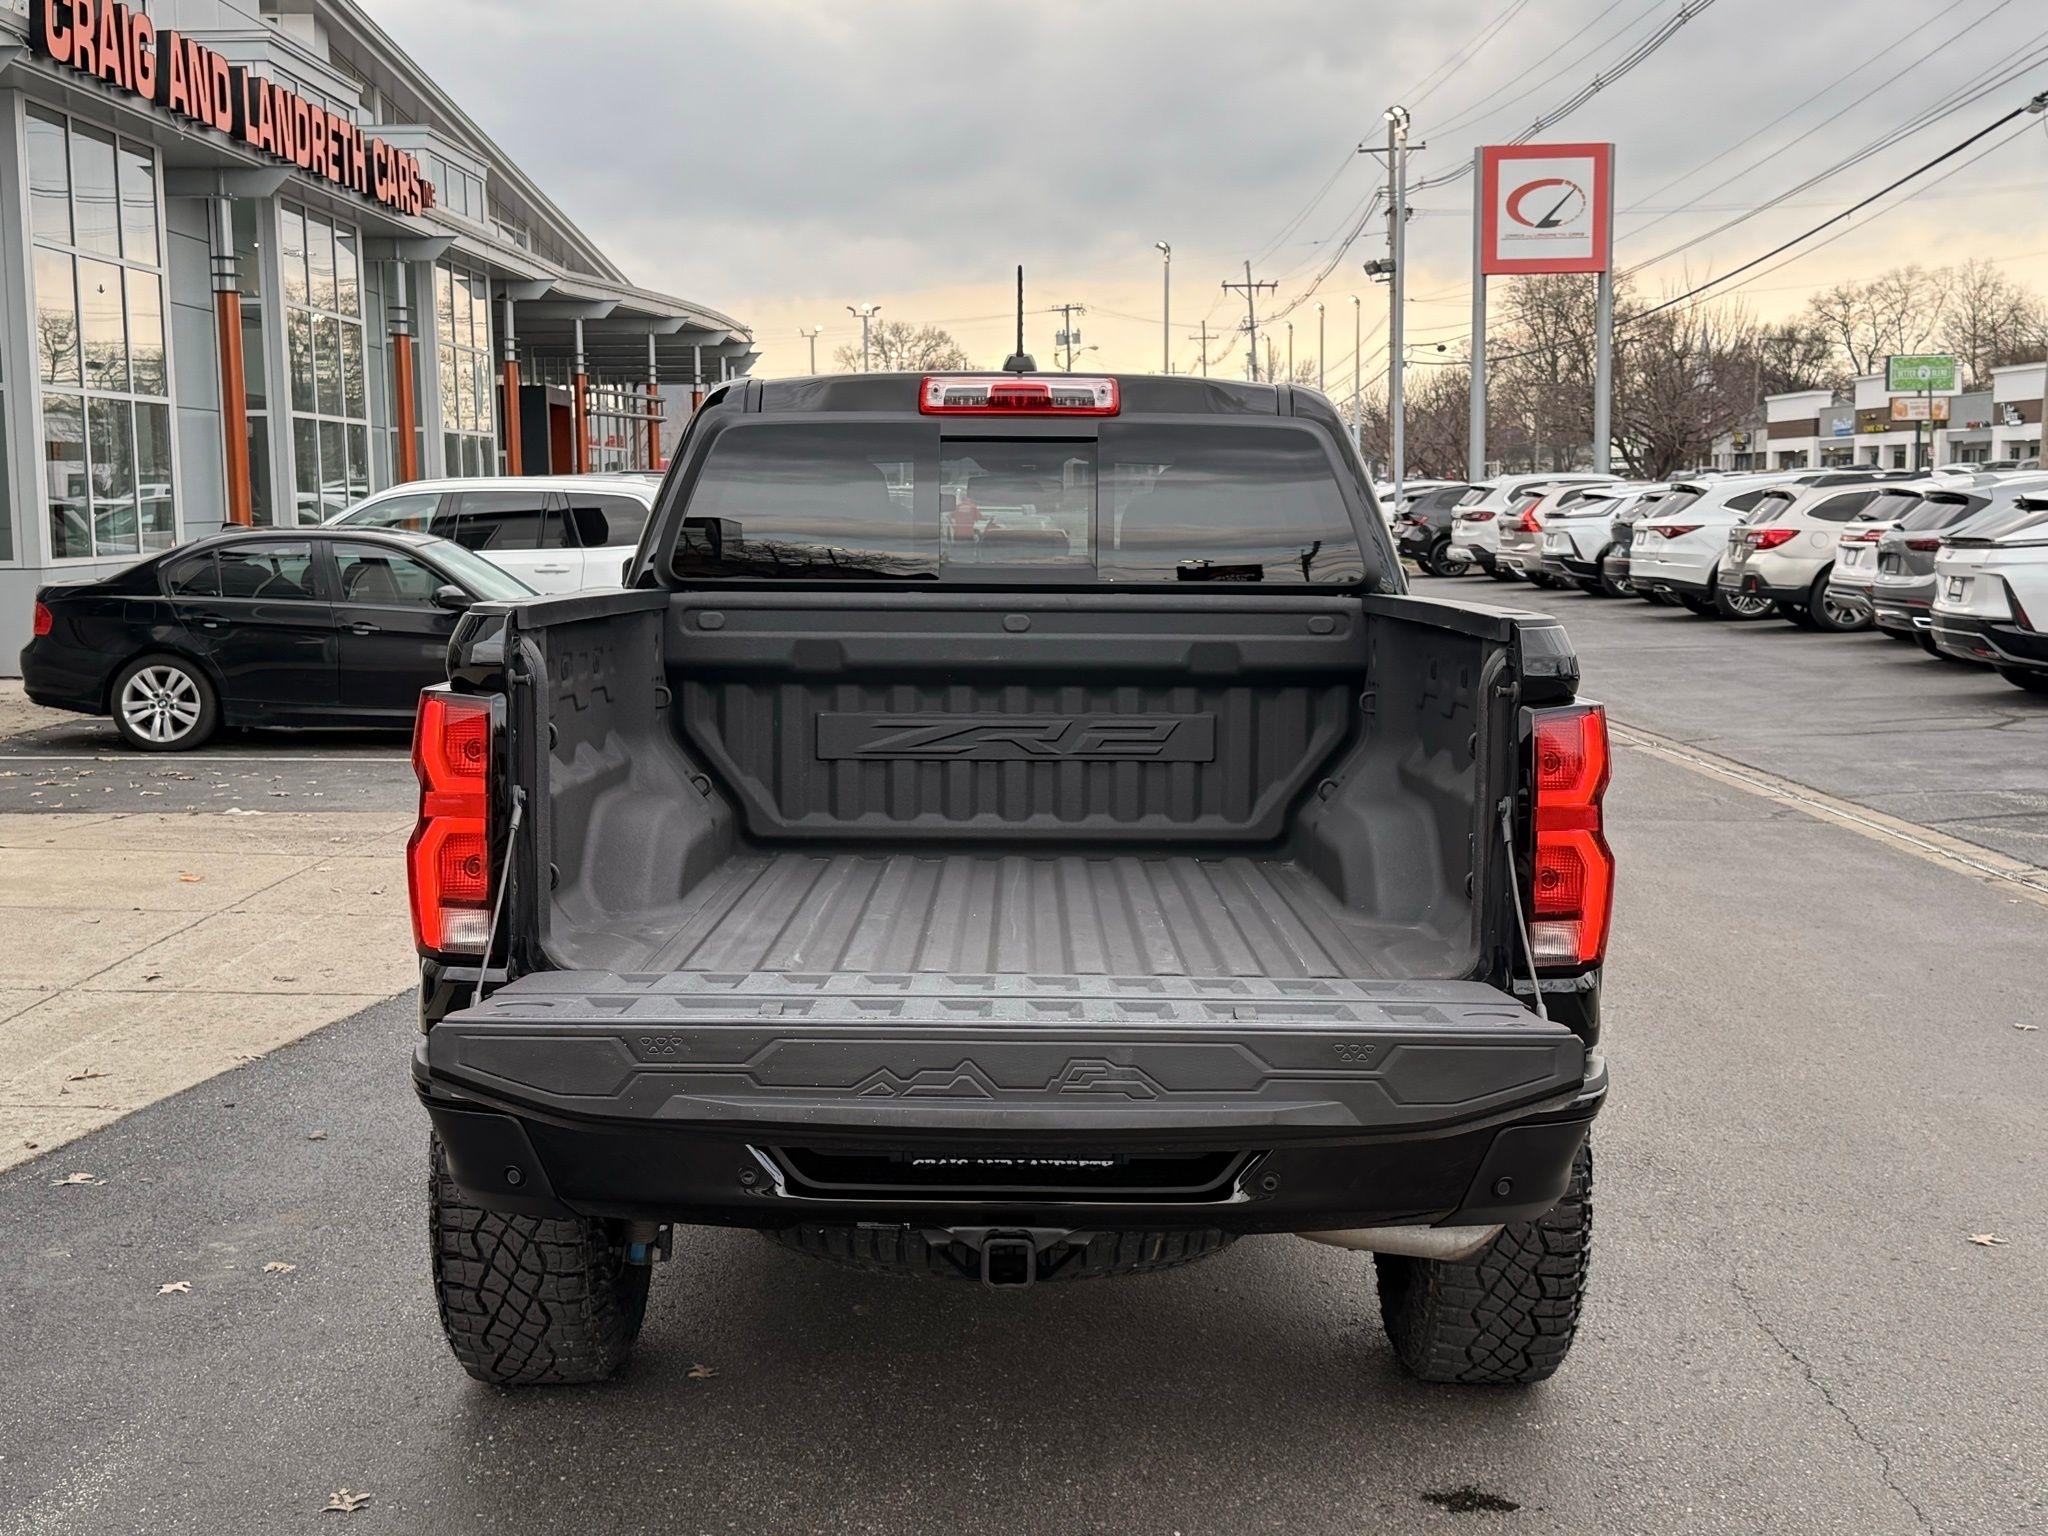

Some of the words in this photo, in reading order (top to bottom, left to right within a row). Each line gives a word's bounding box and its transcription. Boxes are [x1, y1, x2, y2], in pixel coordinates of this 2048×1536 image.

[44, 0, 155, 100] CRAIG
[169, 30, 233, 134] AND
[242, 67, 367, 194] LANDRETH
[372, 137, 422, 217] CARS
[857, 719, 1181, 755] ZR2
